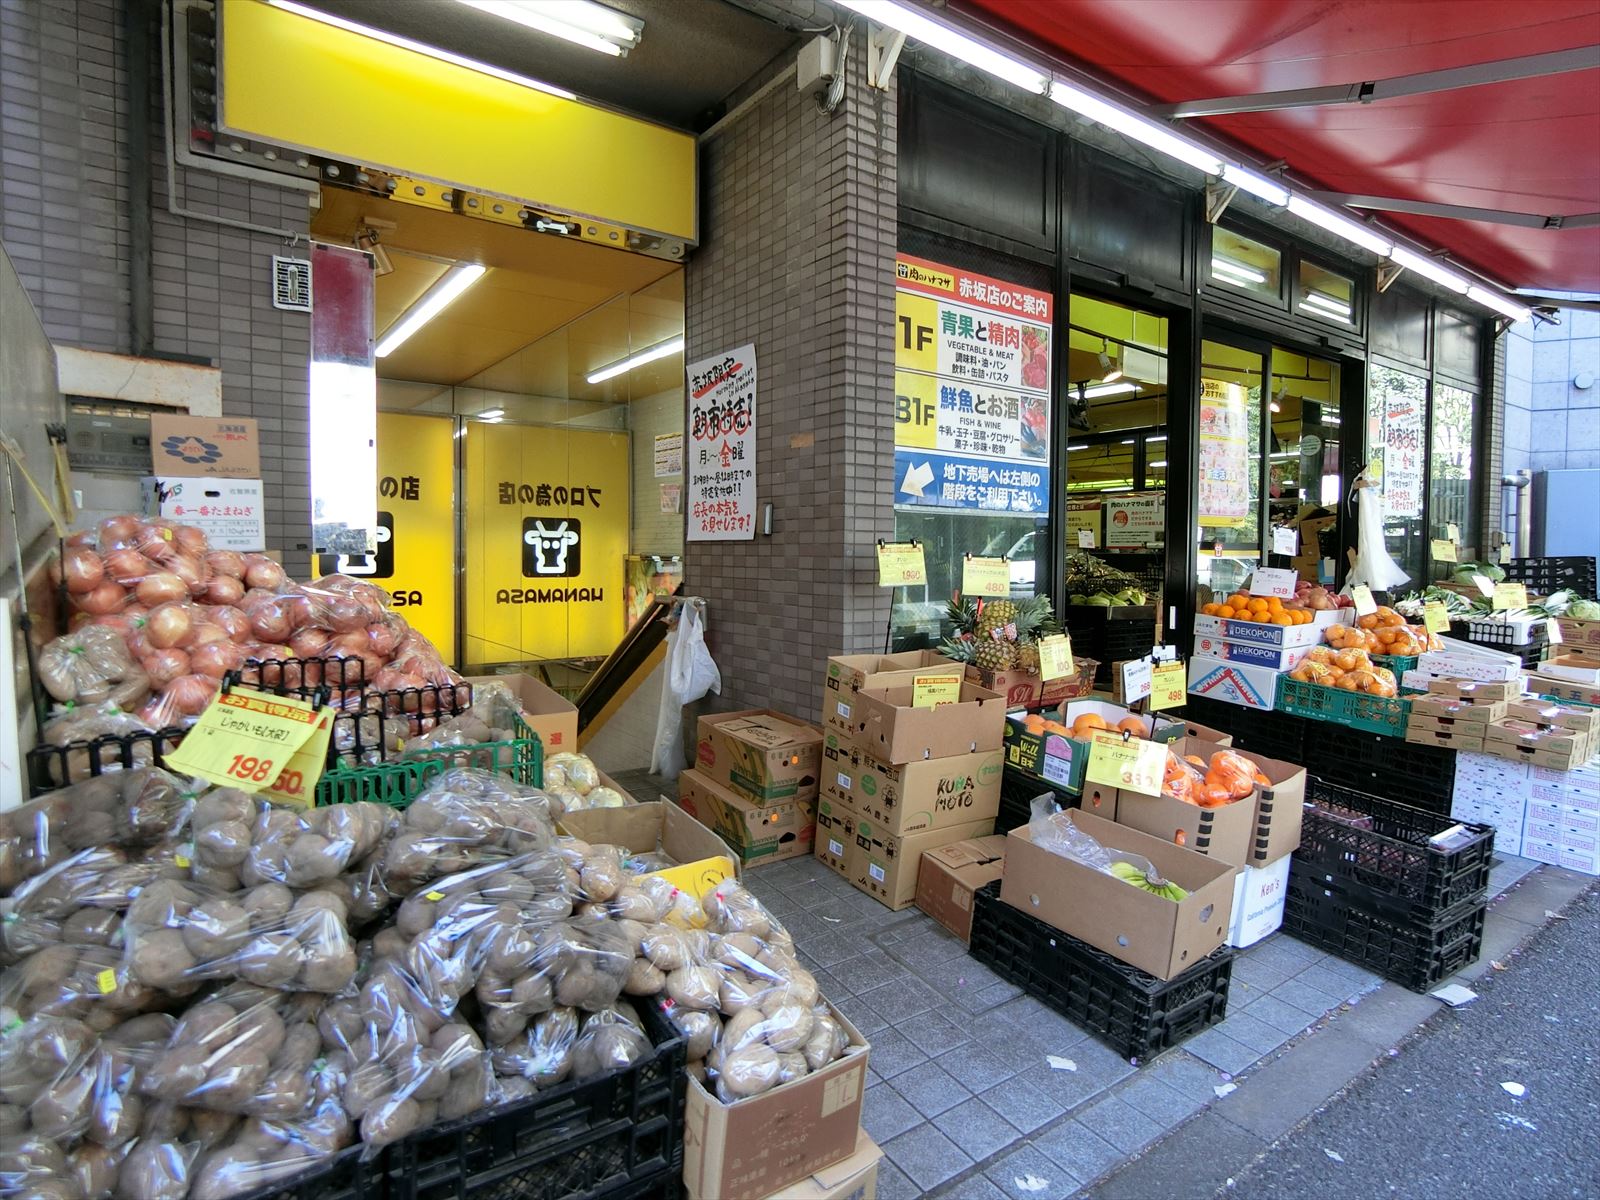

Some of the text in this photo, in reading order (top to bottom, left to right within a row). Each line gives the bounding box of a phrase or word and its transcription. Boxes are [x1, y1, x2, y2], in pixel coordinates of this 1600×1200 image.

[908, 267, 951, 288] 肉のハナマサ
[959, 277, 1048, 318] 赤坂店のご案内
[898, 315, 934, 351] 1F
[941, 310, 1020, 350] 青果と精肉
[947, 340, 1015, 361] VEGETABLE & MEAT
[955, 352, 1007, 370] 調味料・油・パン
[951, 364, 1009, 383] 飲料・缶詰・パスタ
[940, 385, 1019, 420] 鮮魚とお酒
[959, 416, 1001, 430] FISH & WINE
[943, 463, 1040, 487] 地下売場へは左側の
[942, 483, 1042, 506] 階段をご利用下さい。
[174, 504, 254, 517] 春一番たまねぎ
[985, 583, 1004, 593] 480
[1272, 587, 1288, 595] 138
[1235, 626, 1275, 640] DEKOPON
[1238, 646, 1275, 659] DEKOPON
[1168, 690, 1183, 702] 498
[226, 754, 273, 782] 198
[1020, 756, 1035, 769] 日本
[937, 775, 975, 796] KUMA
[935, 791, 974, 813] MOTO
[1260, 878, 1280, 898] Ken's
